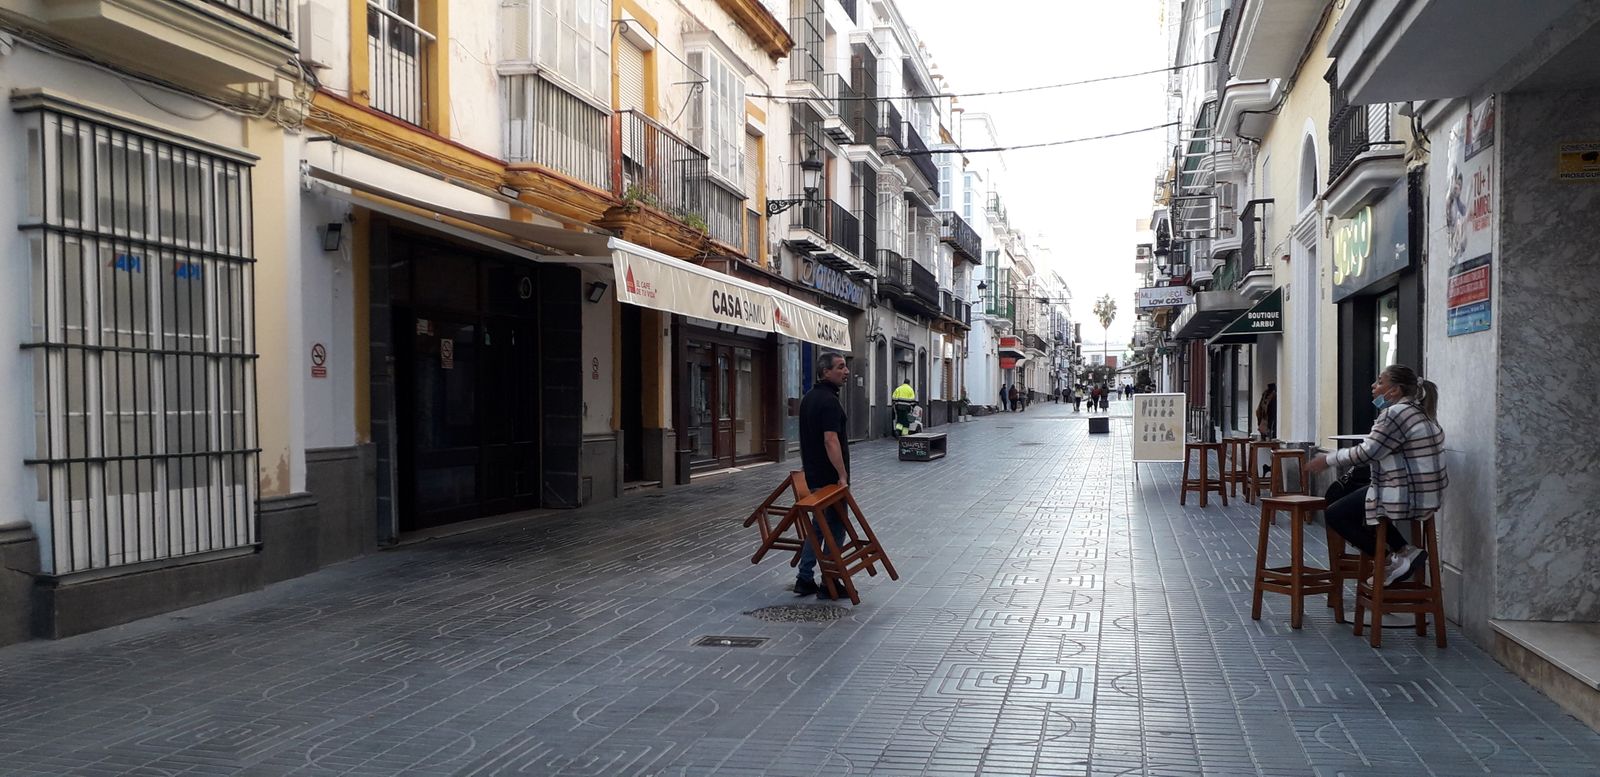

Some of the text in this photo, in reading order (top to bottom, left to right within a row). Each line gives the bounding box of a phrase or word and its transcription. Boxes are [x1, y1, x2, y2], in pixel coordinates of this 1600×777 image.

[712, 289, 743, 320] CASA
[743, 300, 767, 326] SAMU
[1247, 311, 1280, 319] BOUTIQUE
[1251, 320, 1275, 328] JARBU
[817, 321, 833, 343] CASA
